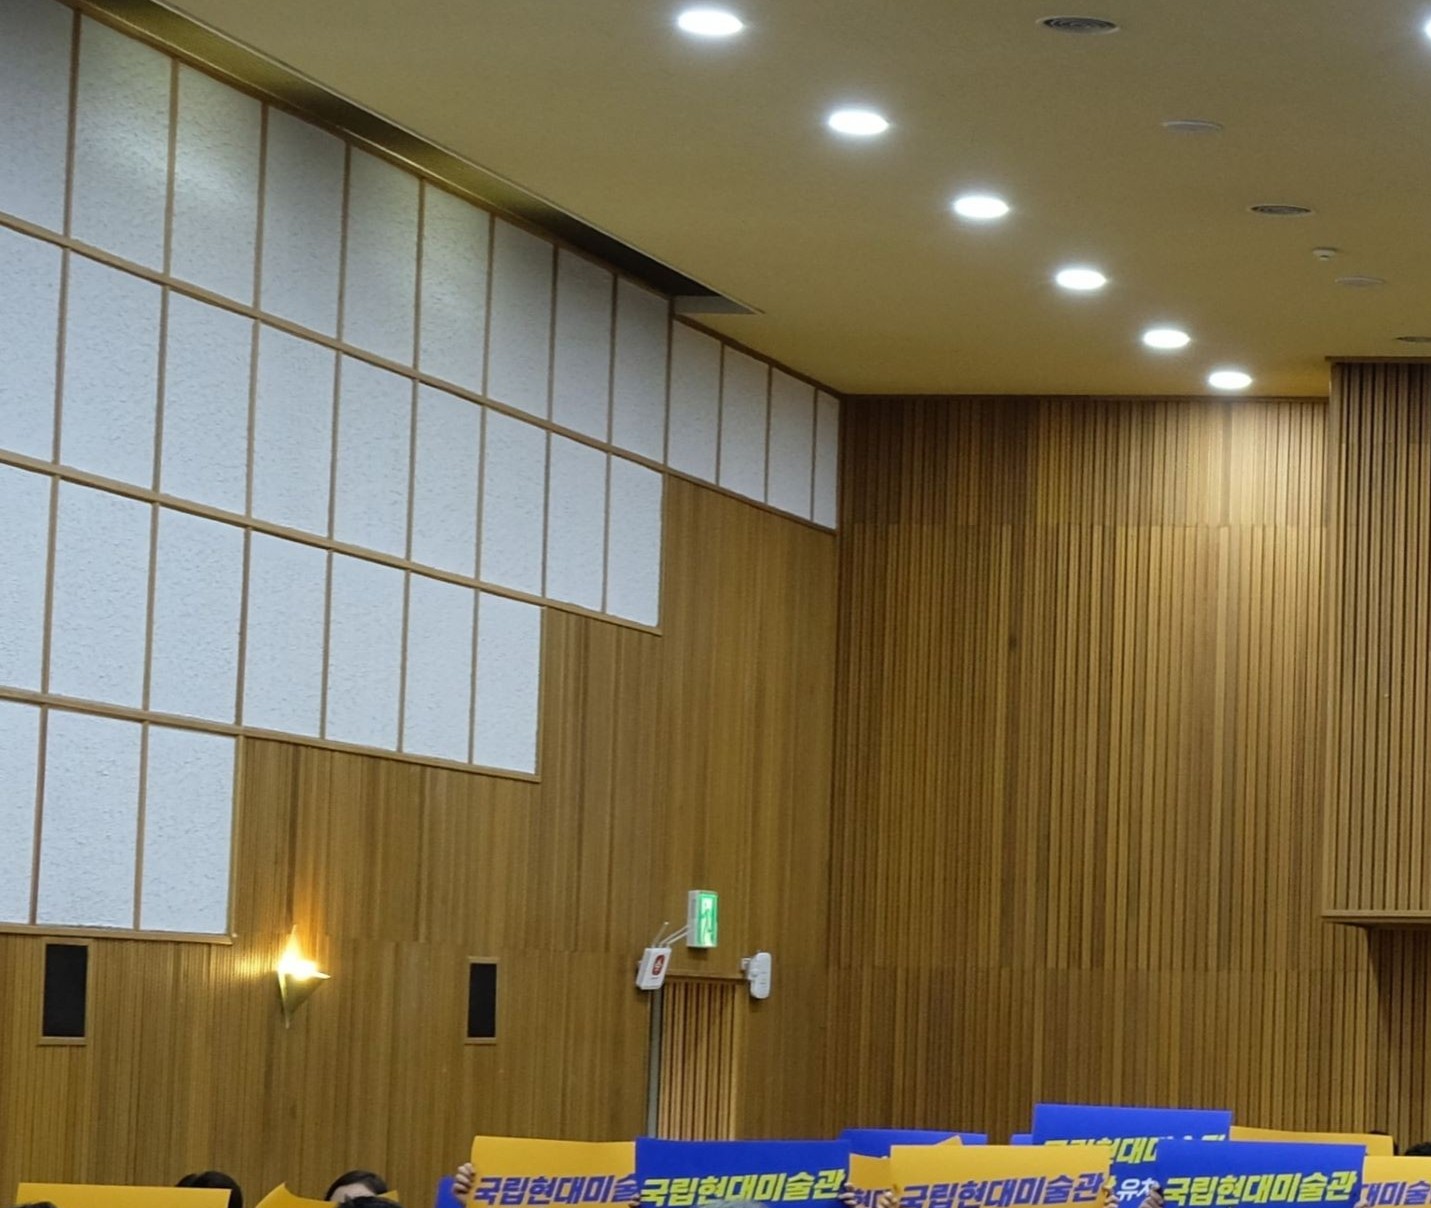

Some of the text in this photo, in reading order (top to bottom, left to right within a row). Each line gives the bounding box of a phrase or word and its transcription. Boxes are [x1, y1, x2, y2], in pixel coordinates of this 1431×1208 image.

[472, 1173, 640, 1206] 국립현대미술
[640, 1168, 846, 1207] 국립현대미술관
[1163, 1170, 1357, 1207] 국립현대미술관
